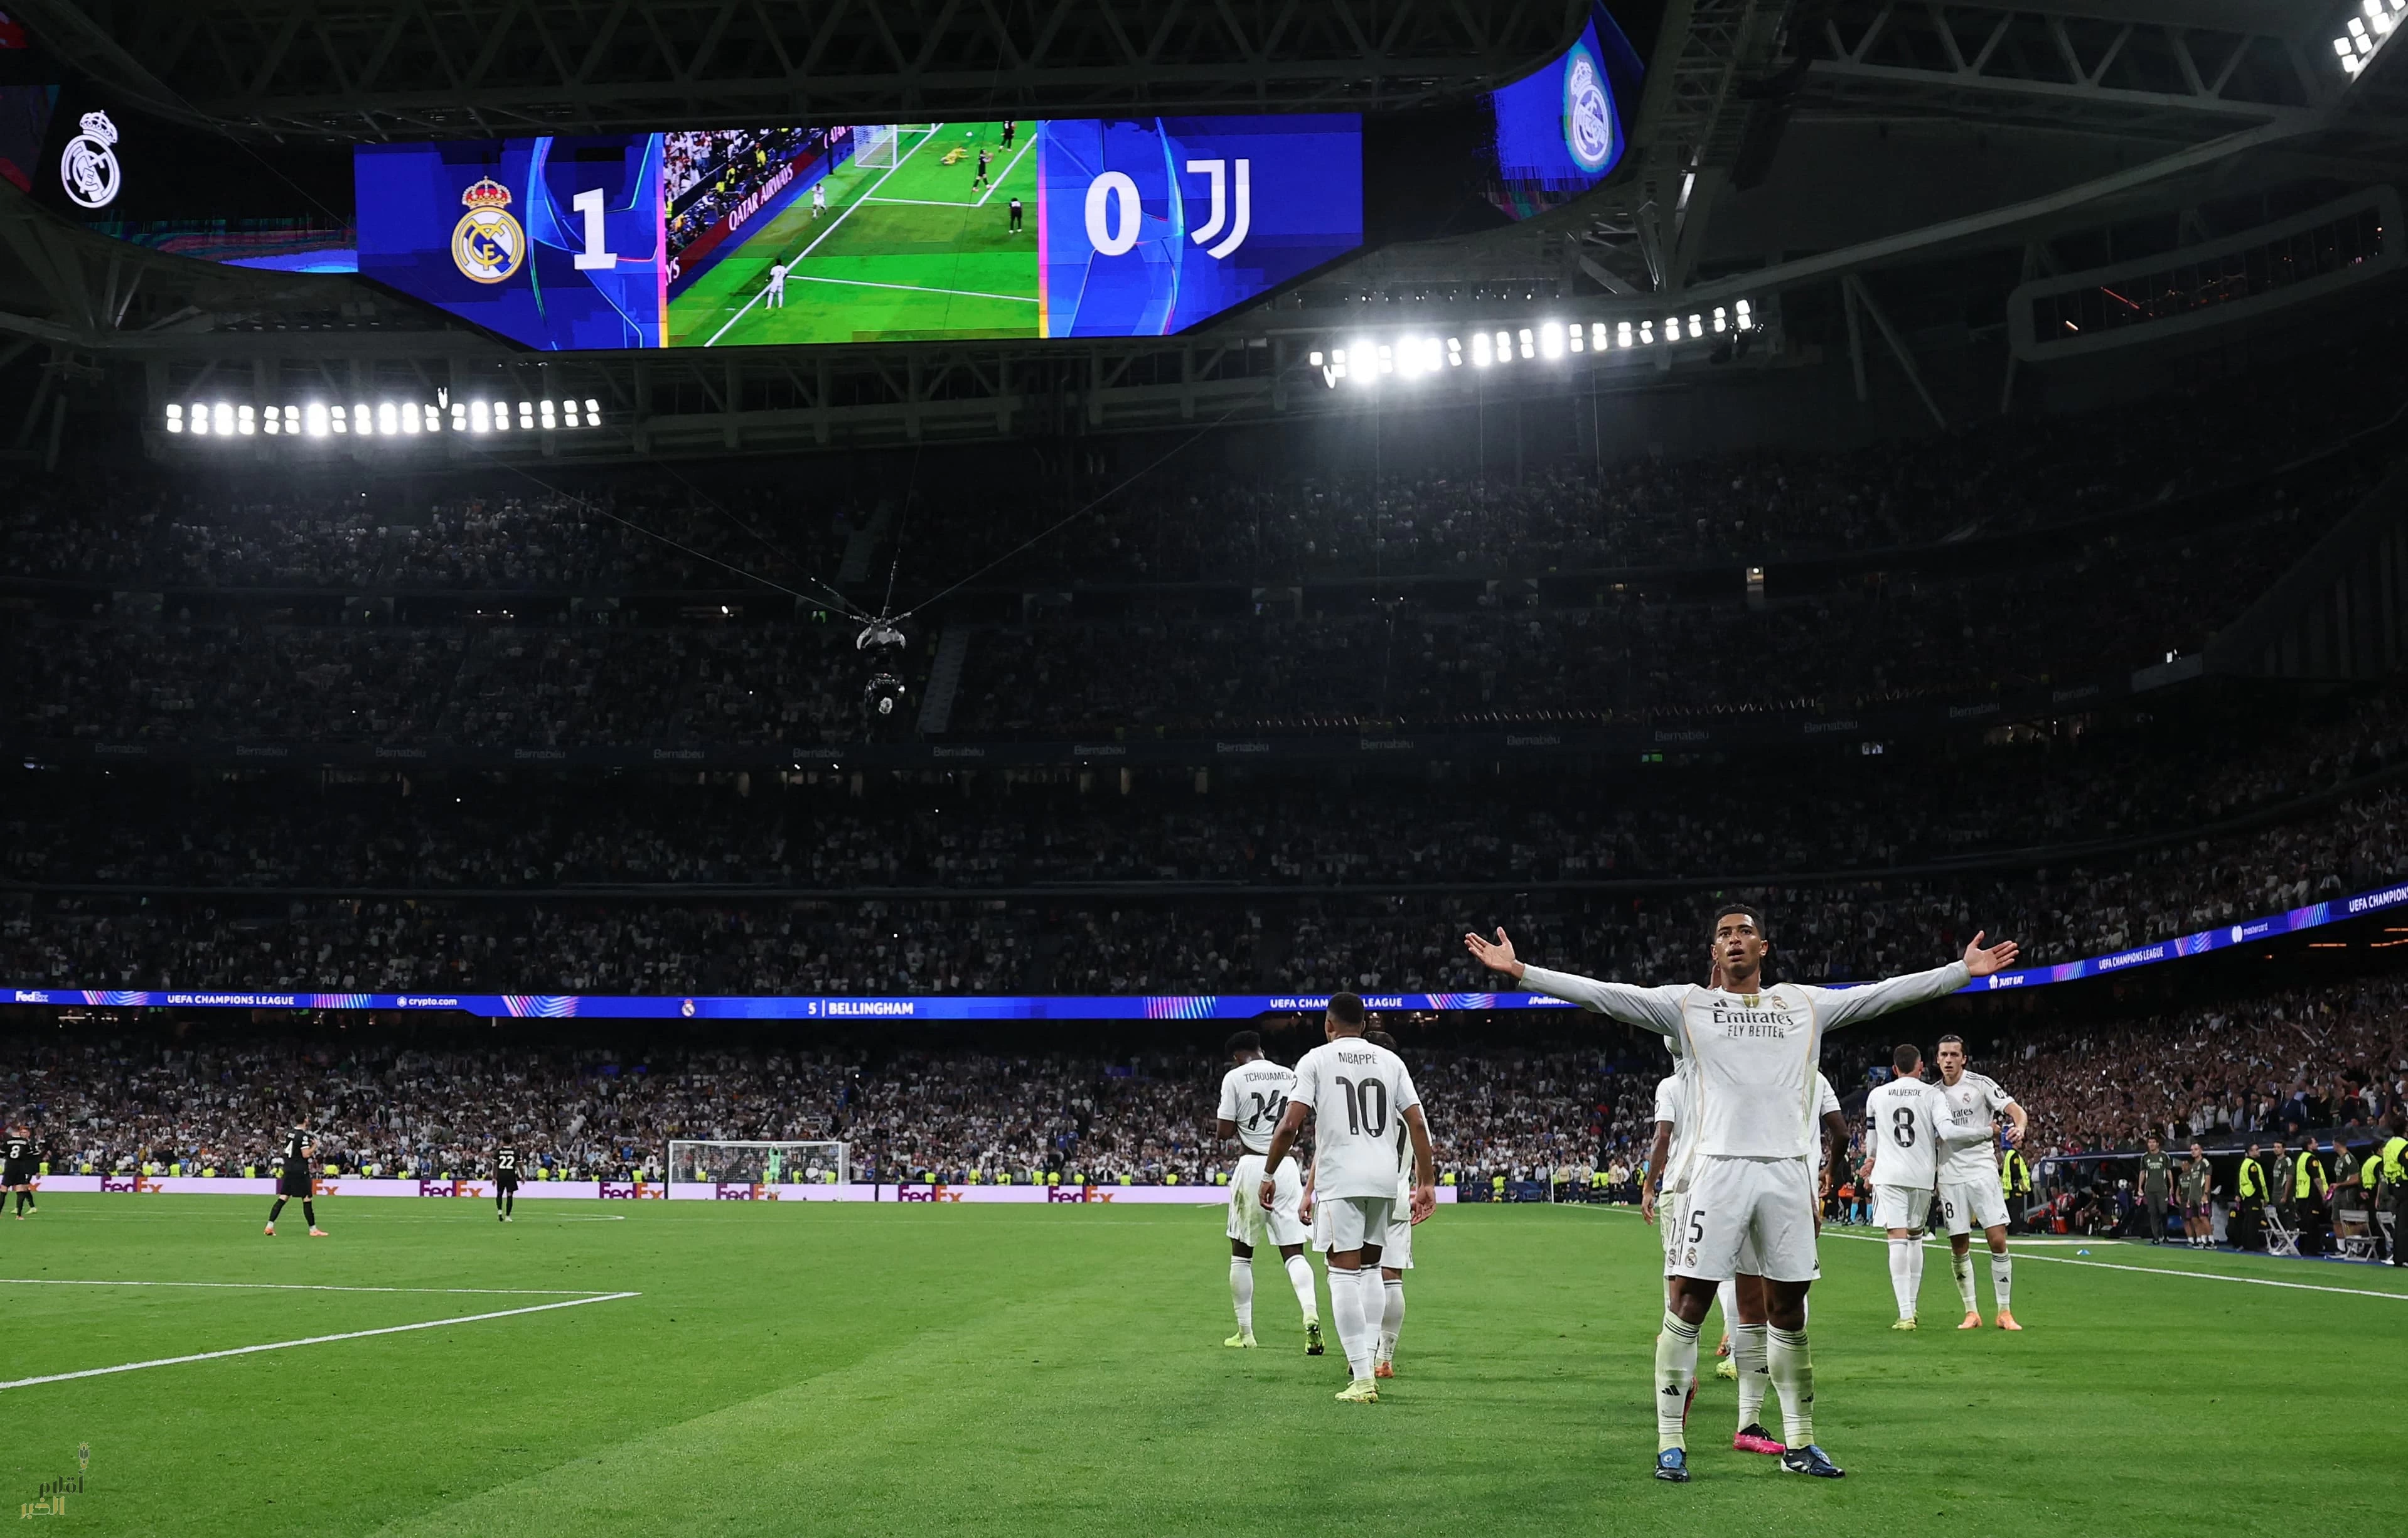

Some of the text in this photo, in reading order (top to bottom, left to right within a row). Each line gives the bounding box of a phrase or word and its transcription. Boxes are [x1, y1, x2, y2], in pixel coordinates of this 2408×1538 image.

[729, 163, 793, 231] QATAR AIRWAYS
[1085, 171, 1142, 256] 0
[573, 188, 618, 270] 1
[2349, 900, 2367, 912] UEFA
[2244, 922, 2268, 936] mastercard
[2099, 946, 2164, 970] UEFA CHAMPIONS LEAGUE
[1999, 976, 2024, 987] JUST EAT
[16, 991, 48, 1002] FedEx
[168, 995, 294, 1005] UEFA CHAMPIONS LEAGUE
[409, 998, 457, 1006] crypto.com
[1270, 999, 1297, 1008] UEFA
[1364, 998, 1403, 1007] LEAGUE
[808, 1002, 914, 1014] 5 BELLINGHAM
[1713, 1009, 1794, 1026] Emirates
[1728, 1025, 1784, 1039] FLY BETTER
[1338, 1051, 1378, 1065] MBAPPÉ
[1888, 1089, 1922, 1097] VALVERDE
[1248, 1089, 1288, 1135] 14
[1335, 1076, 1386, 1137] 10
[1950, 1108, 1974, 1118] rates
[1892, 1107, 1915, 1148] 8
[9, 1145, 20, 1159] 8
[285, 1141, 293, 1158] 4
[499, 1155, 515, 1170] 22
[101, 1176, 163, 1193] FedEx
[420, 1180, 483, 1197] FedEx
[599, 1183, 664, 1200] FedEx
[898, 1185, 963, 1203] FedEx
[1048, 1185, 1114, 1203] FedEx
[1689, 1210, 1705, 1243] 5
